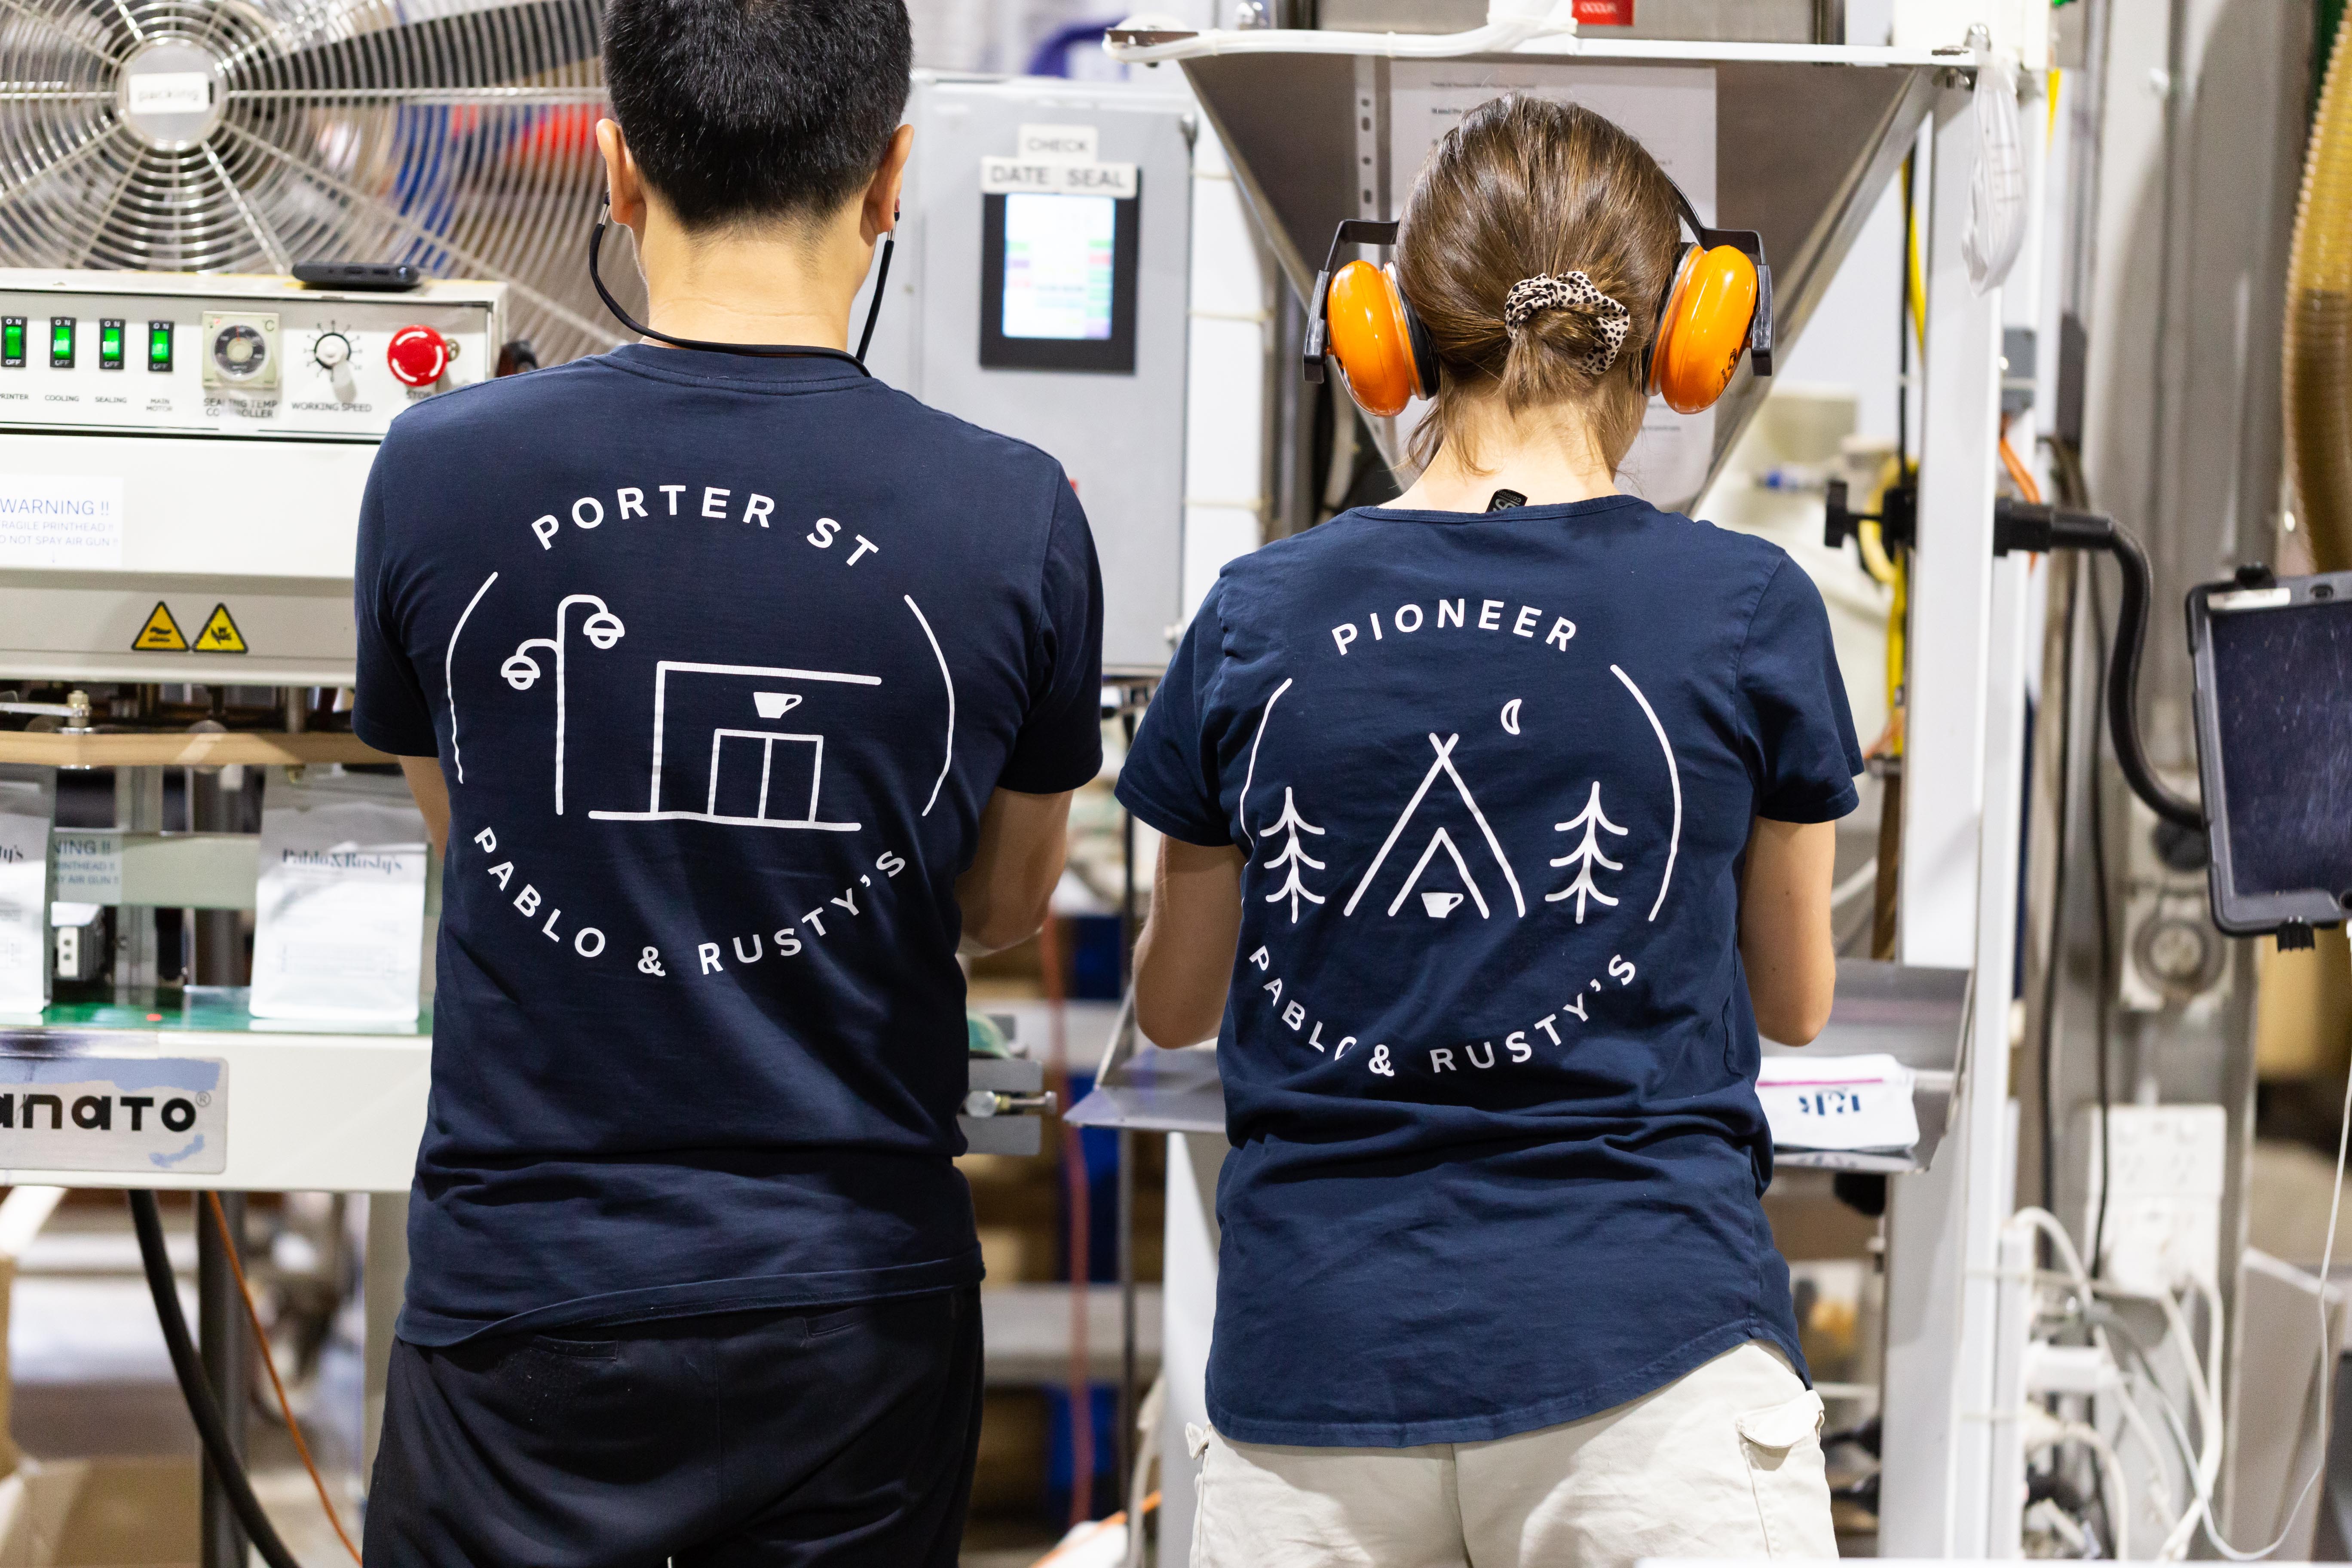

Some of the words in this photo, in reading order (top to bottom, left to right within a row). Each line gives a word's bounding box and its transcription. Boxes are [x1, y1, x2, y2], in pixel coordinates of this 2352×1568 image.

[1028, 138, 1087, 151] CHECK
[991, 165, 1049, 184] DATE
[1066, 168, 1126, 188] SEAL
[251, 399, 278, 409] TEMP
[292, 401, 339, 411] WORKING
[341, 402, 372, 412] SPEED
[0, 499, 94, 515] WARNING
[0, 520, 39, 530] RAGILE
[43, 521, 106, 532] PRINTHEAD
[531, 485, 775, 550] PORTER
[807, 518, 879, 566] ST
[10, 536, 31, 544] NOT
[36, 536, 62, 545] SPAY
[66, 537, 83, 545] AIR
[86, 537, 110, 546] GUN
[1332, 599, 1576, 655] PIONEER
[475, 827, 605, 957] PABLO
[638, 946, 666, 976] &
[698, 851, 905, 975] RUSTY'S
[1369, 1044, 1394, 1076] &
[1430, 955, 1635, 1072] RUSTY'S
